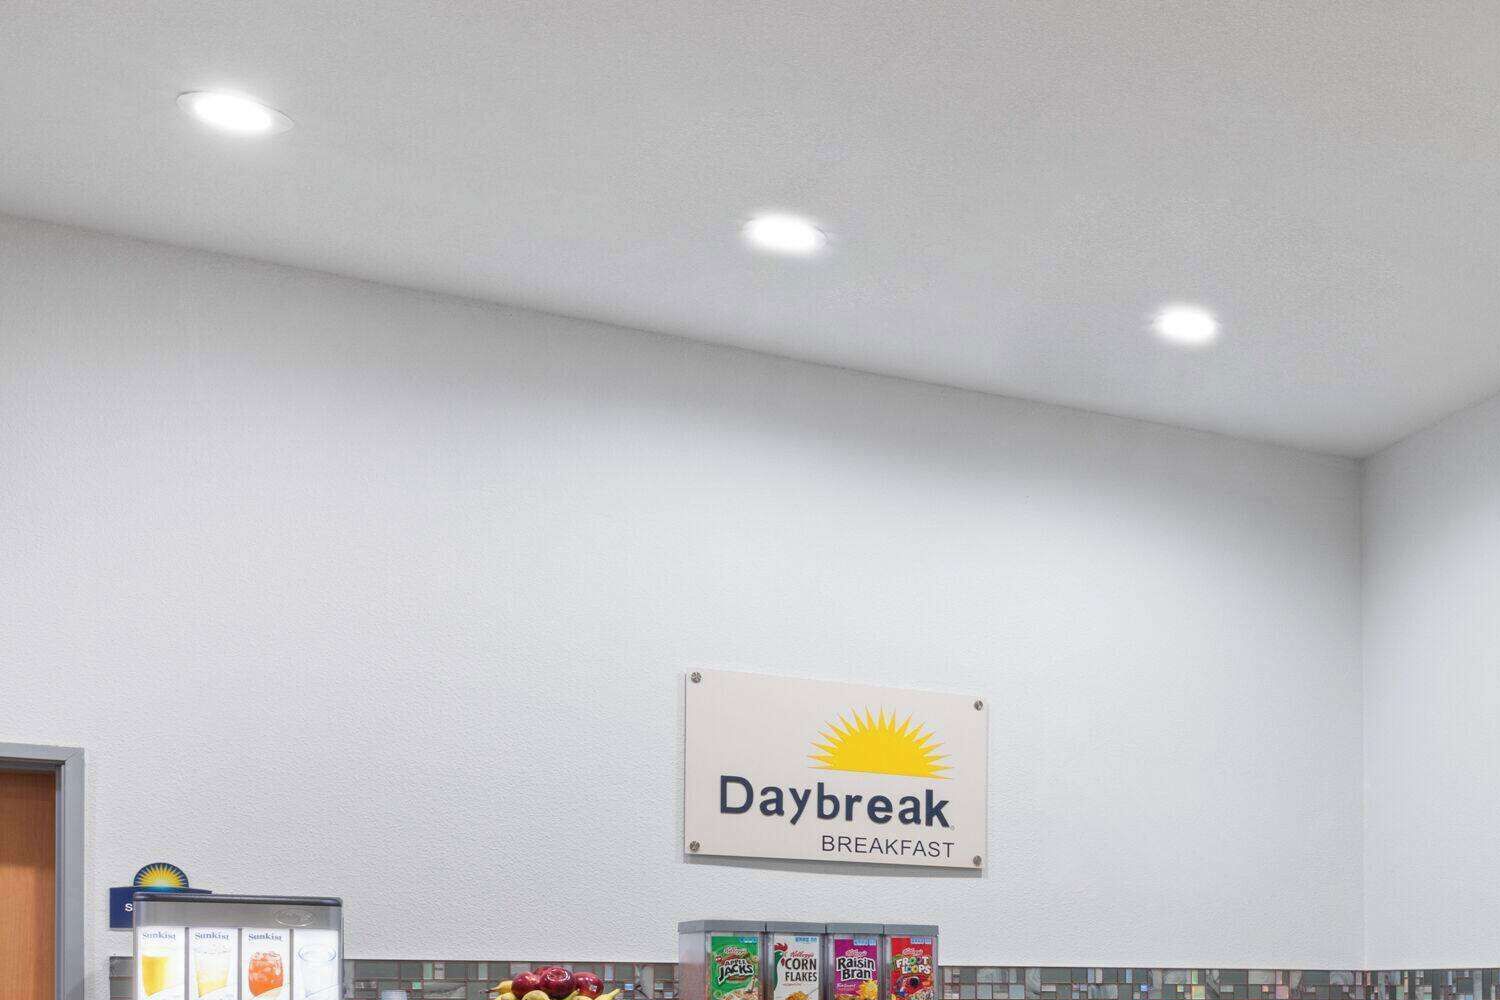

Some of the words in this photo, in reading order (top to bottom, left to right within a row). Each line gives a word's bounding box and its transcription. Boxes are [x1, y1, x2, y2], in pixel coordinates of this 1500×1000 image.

[719, 774, 951, 828] Daybreak
[821, 834, 955, 858] BREAKFAST
[142, 931, 176, 941] Sunkist
[194, 931, 230, 941] Sunkist
[248, 932, 283, 942] Sunkist
[785, 958, 817, 970] CORN
[837, 956, 875, 970] Raisin
[718, 963, 754, 983] JACKS
[785, 971, 818, 982] FLAKES
[841, 967, 872, 980] Bran
